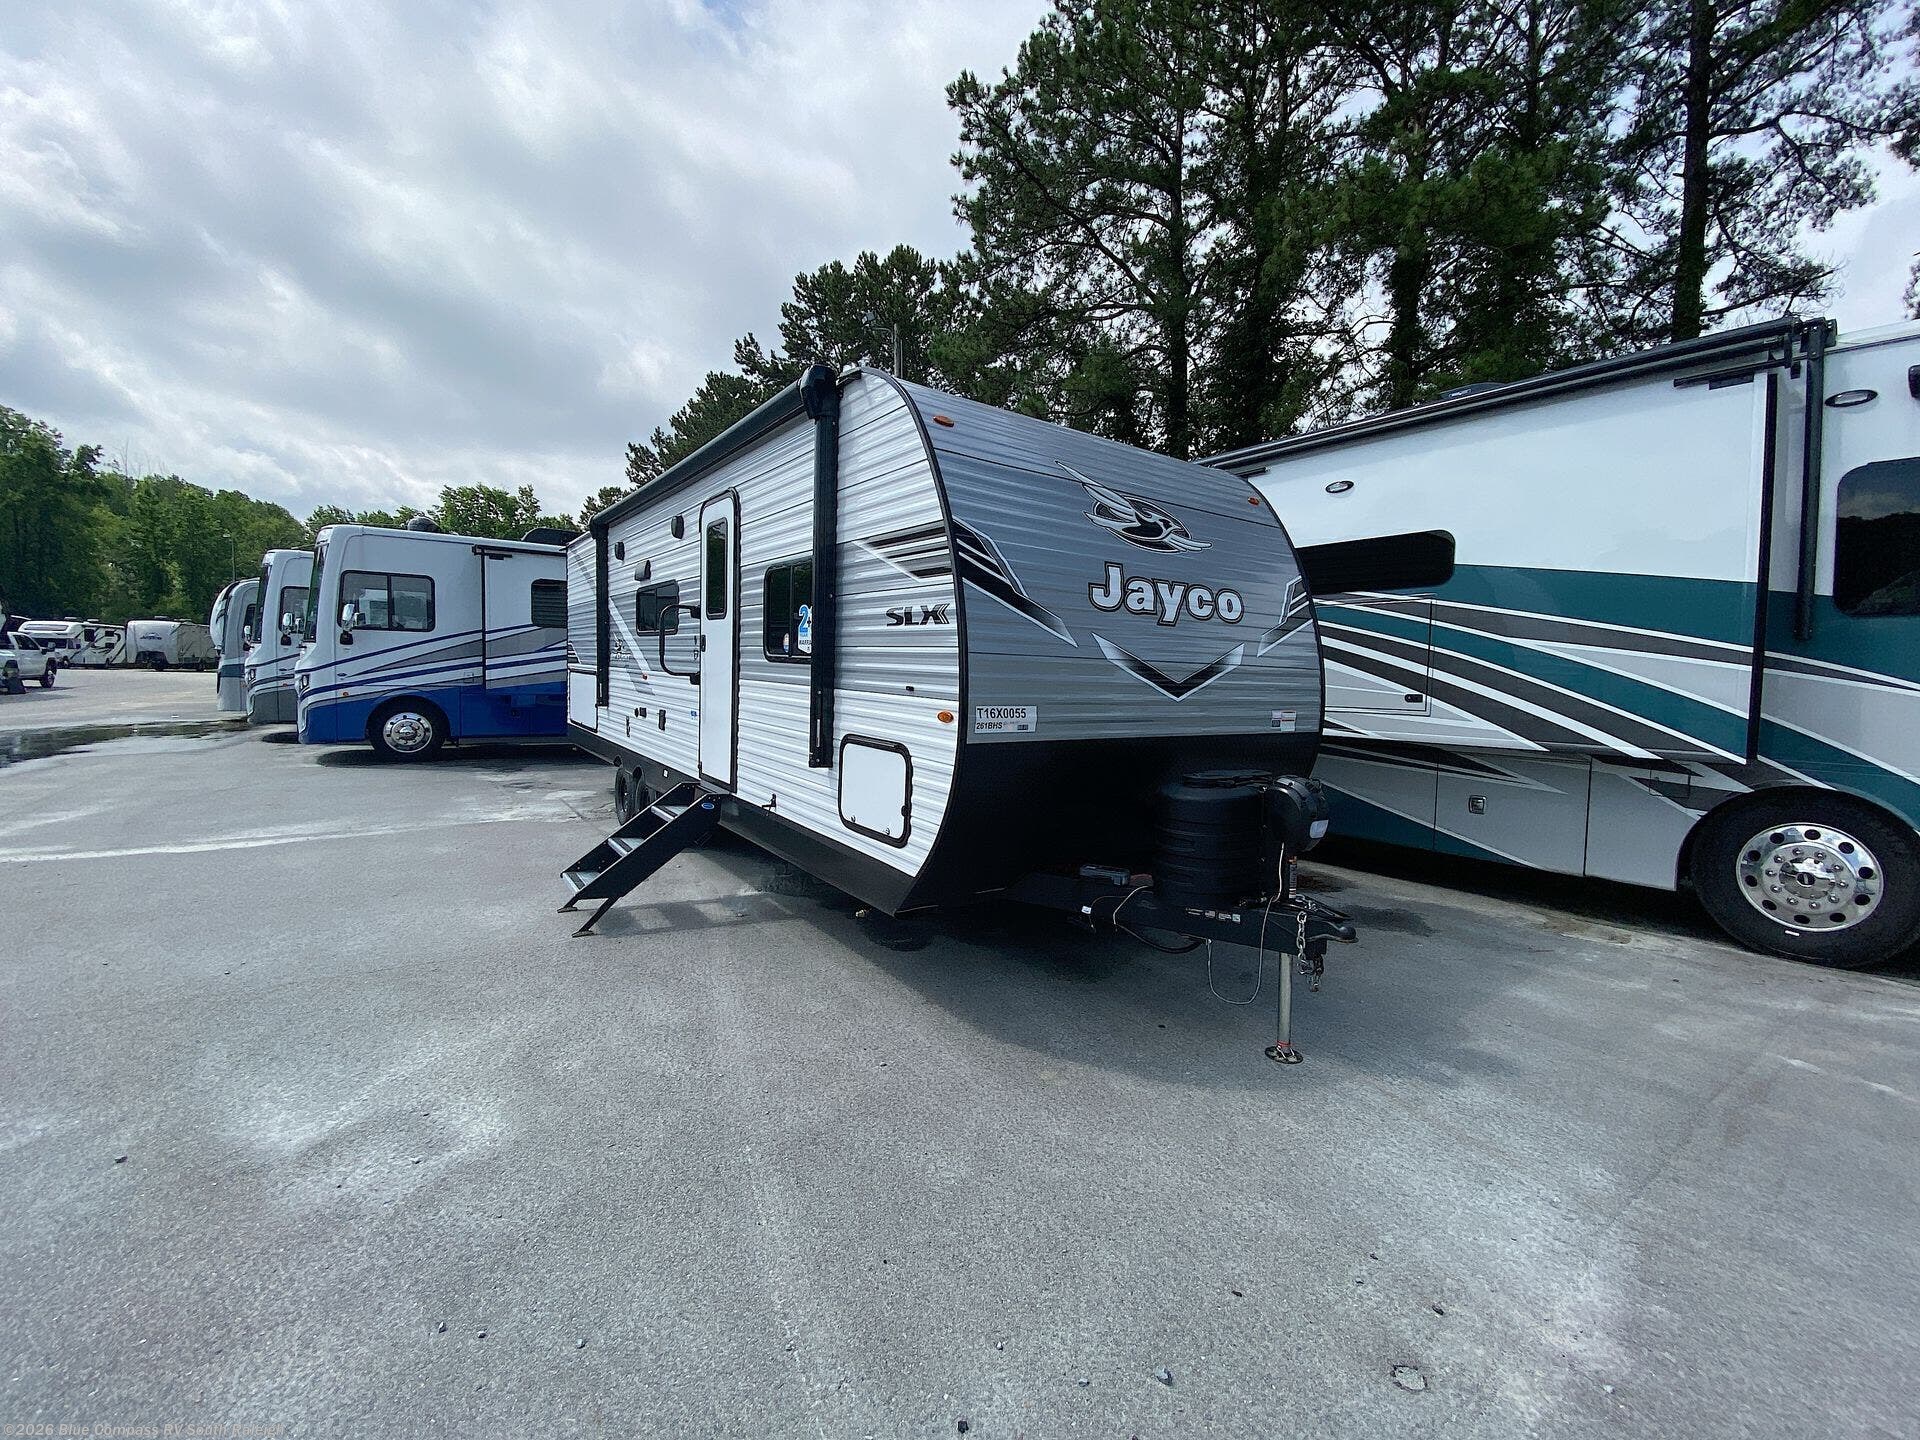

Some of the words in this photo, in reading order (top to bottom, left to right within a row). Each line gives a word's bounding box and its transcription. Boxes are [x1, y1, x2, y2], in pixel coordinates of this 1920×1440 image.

[1088, 561, 1245, 627] Jayco
[885, 603, 950, 627] SLX
[977, 708, 1027, 719] T16X0055
